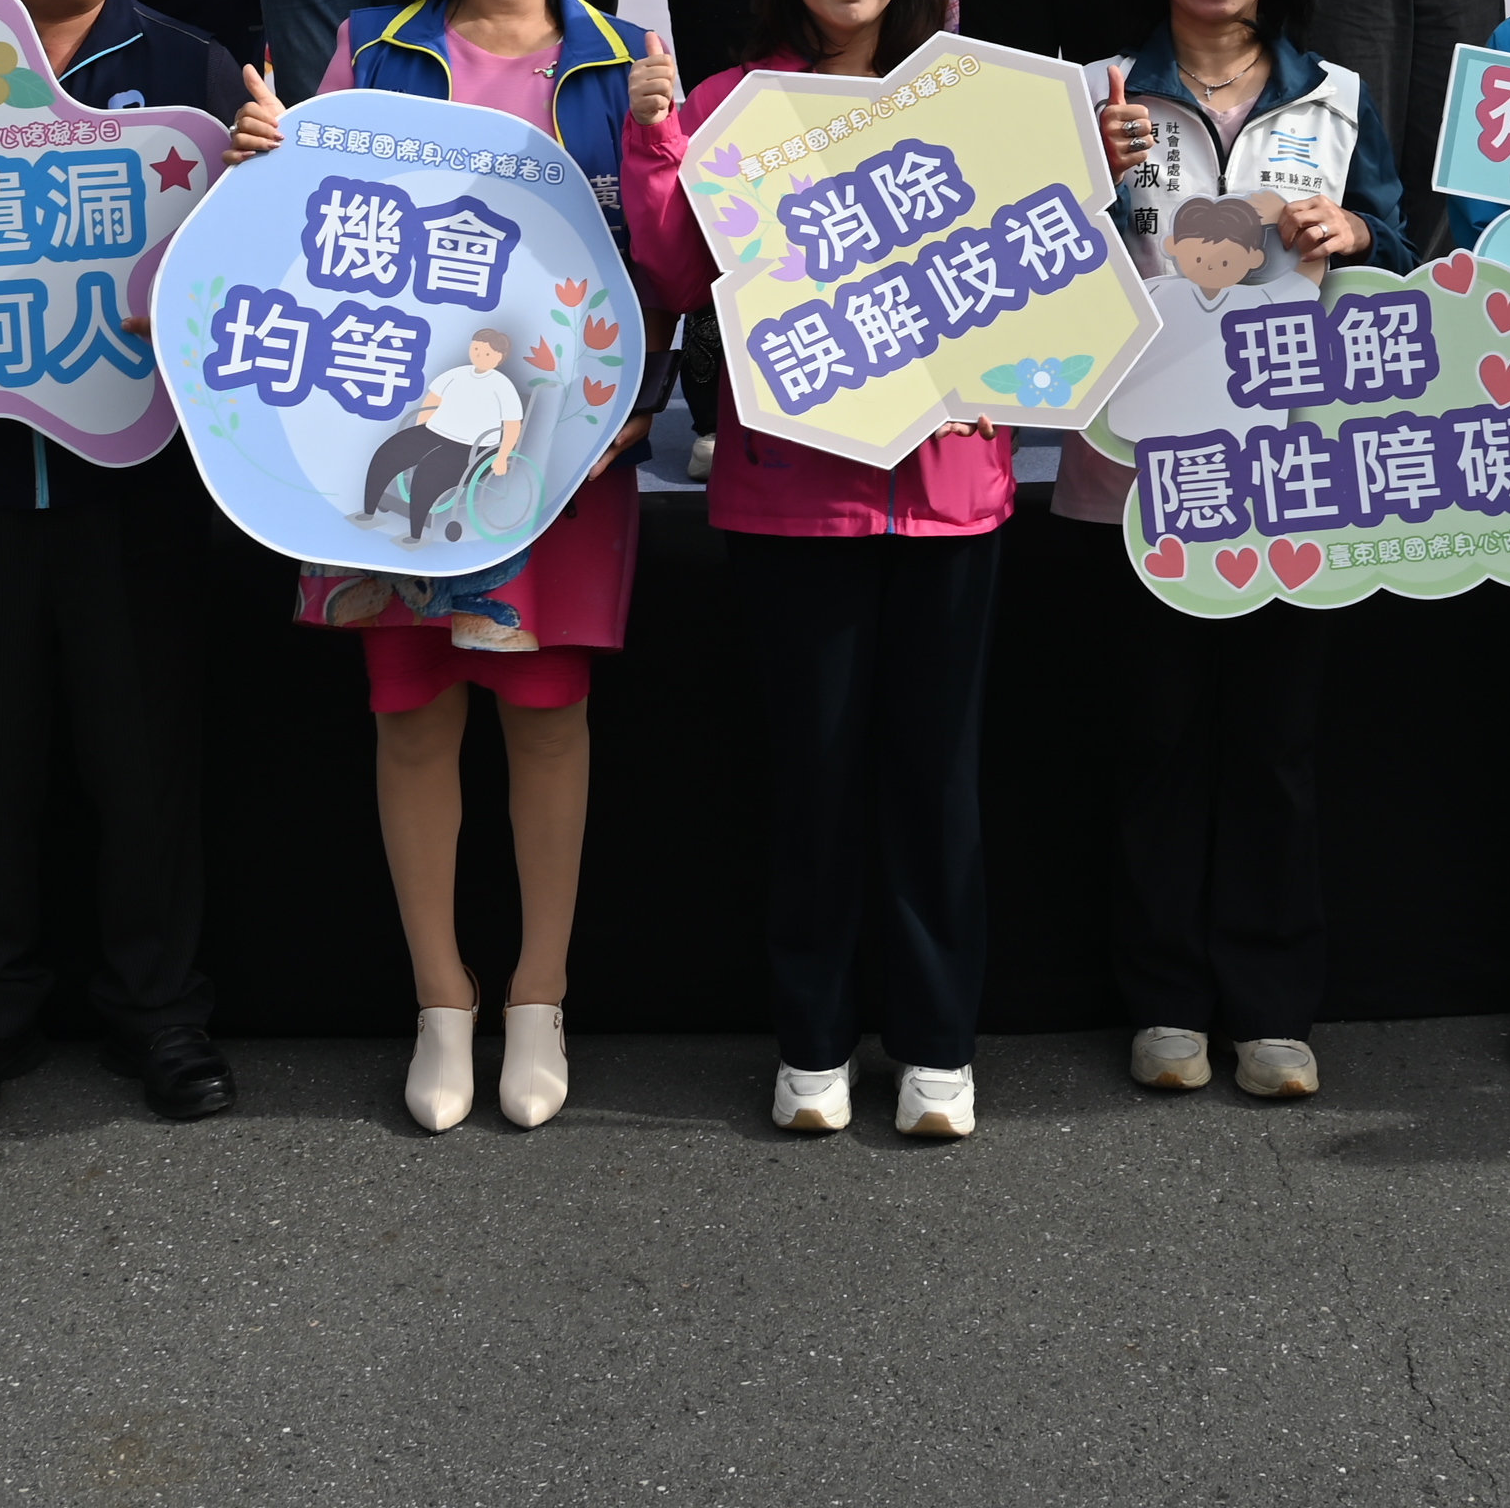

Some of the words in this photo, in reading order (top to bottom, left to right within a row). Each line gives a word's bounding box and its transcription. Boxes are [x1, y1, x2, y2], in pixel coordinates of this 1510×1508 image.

[295, 120, 565, 185] 臺東縣國際身心障礙者日
[737, 53, 981, 183] 臺東縣國際身心障礙者日
[1165, 121, 1181, 192] 社會處處長
[790, 151, 962, 271] 消除
[1259, 170, 1323, 189] 臺東縣政府
[314, 189, 507, 299] 機會
[759, 195, 1095, 402] 誤解歧視
[217, 298, 418, 408] 均等
[1233, 302, 1427, 398] 理解
